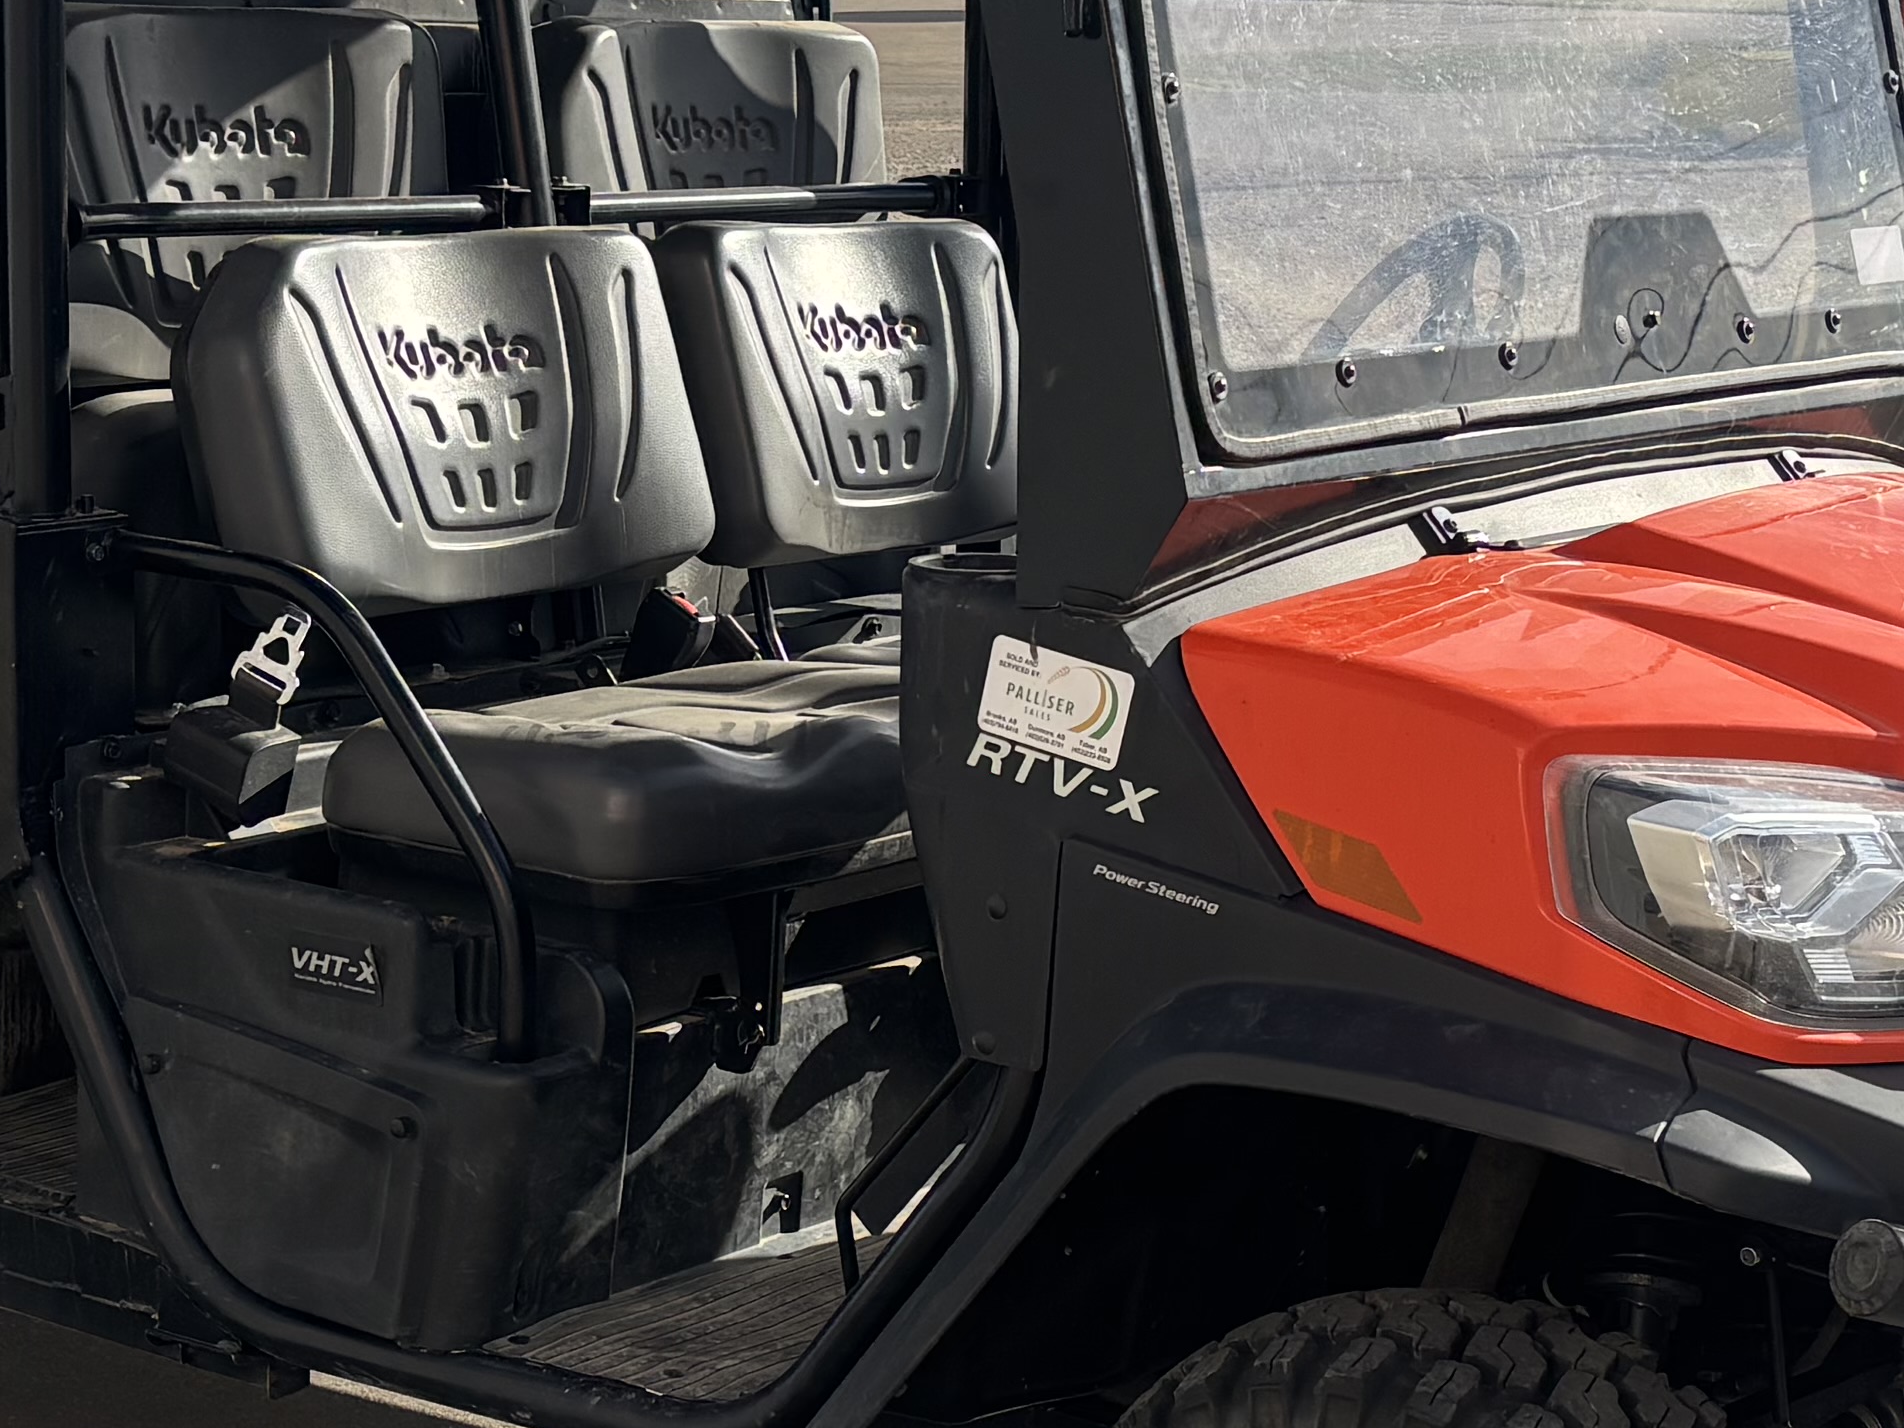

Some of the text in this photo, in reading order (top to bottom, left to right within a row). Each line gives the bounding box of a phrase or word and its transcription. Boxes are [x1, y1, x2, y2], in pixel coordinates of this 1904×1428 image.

[142, 104, 312, 159] Kubota
[651, 104, 780, 155] Kubota
[376, 324, 546, 381] Kubota
[796, 300, 932, 354] Kubota
[1006, 682, 1075, 716] PALLISER
[1024, 706, 1051, 721] SALES
[966, 732, 1160, 823] RTV-X
[1093, 864, 1220, 915] Power Steering
[291, 947, 376, 984] VHT-X
